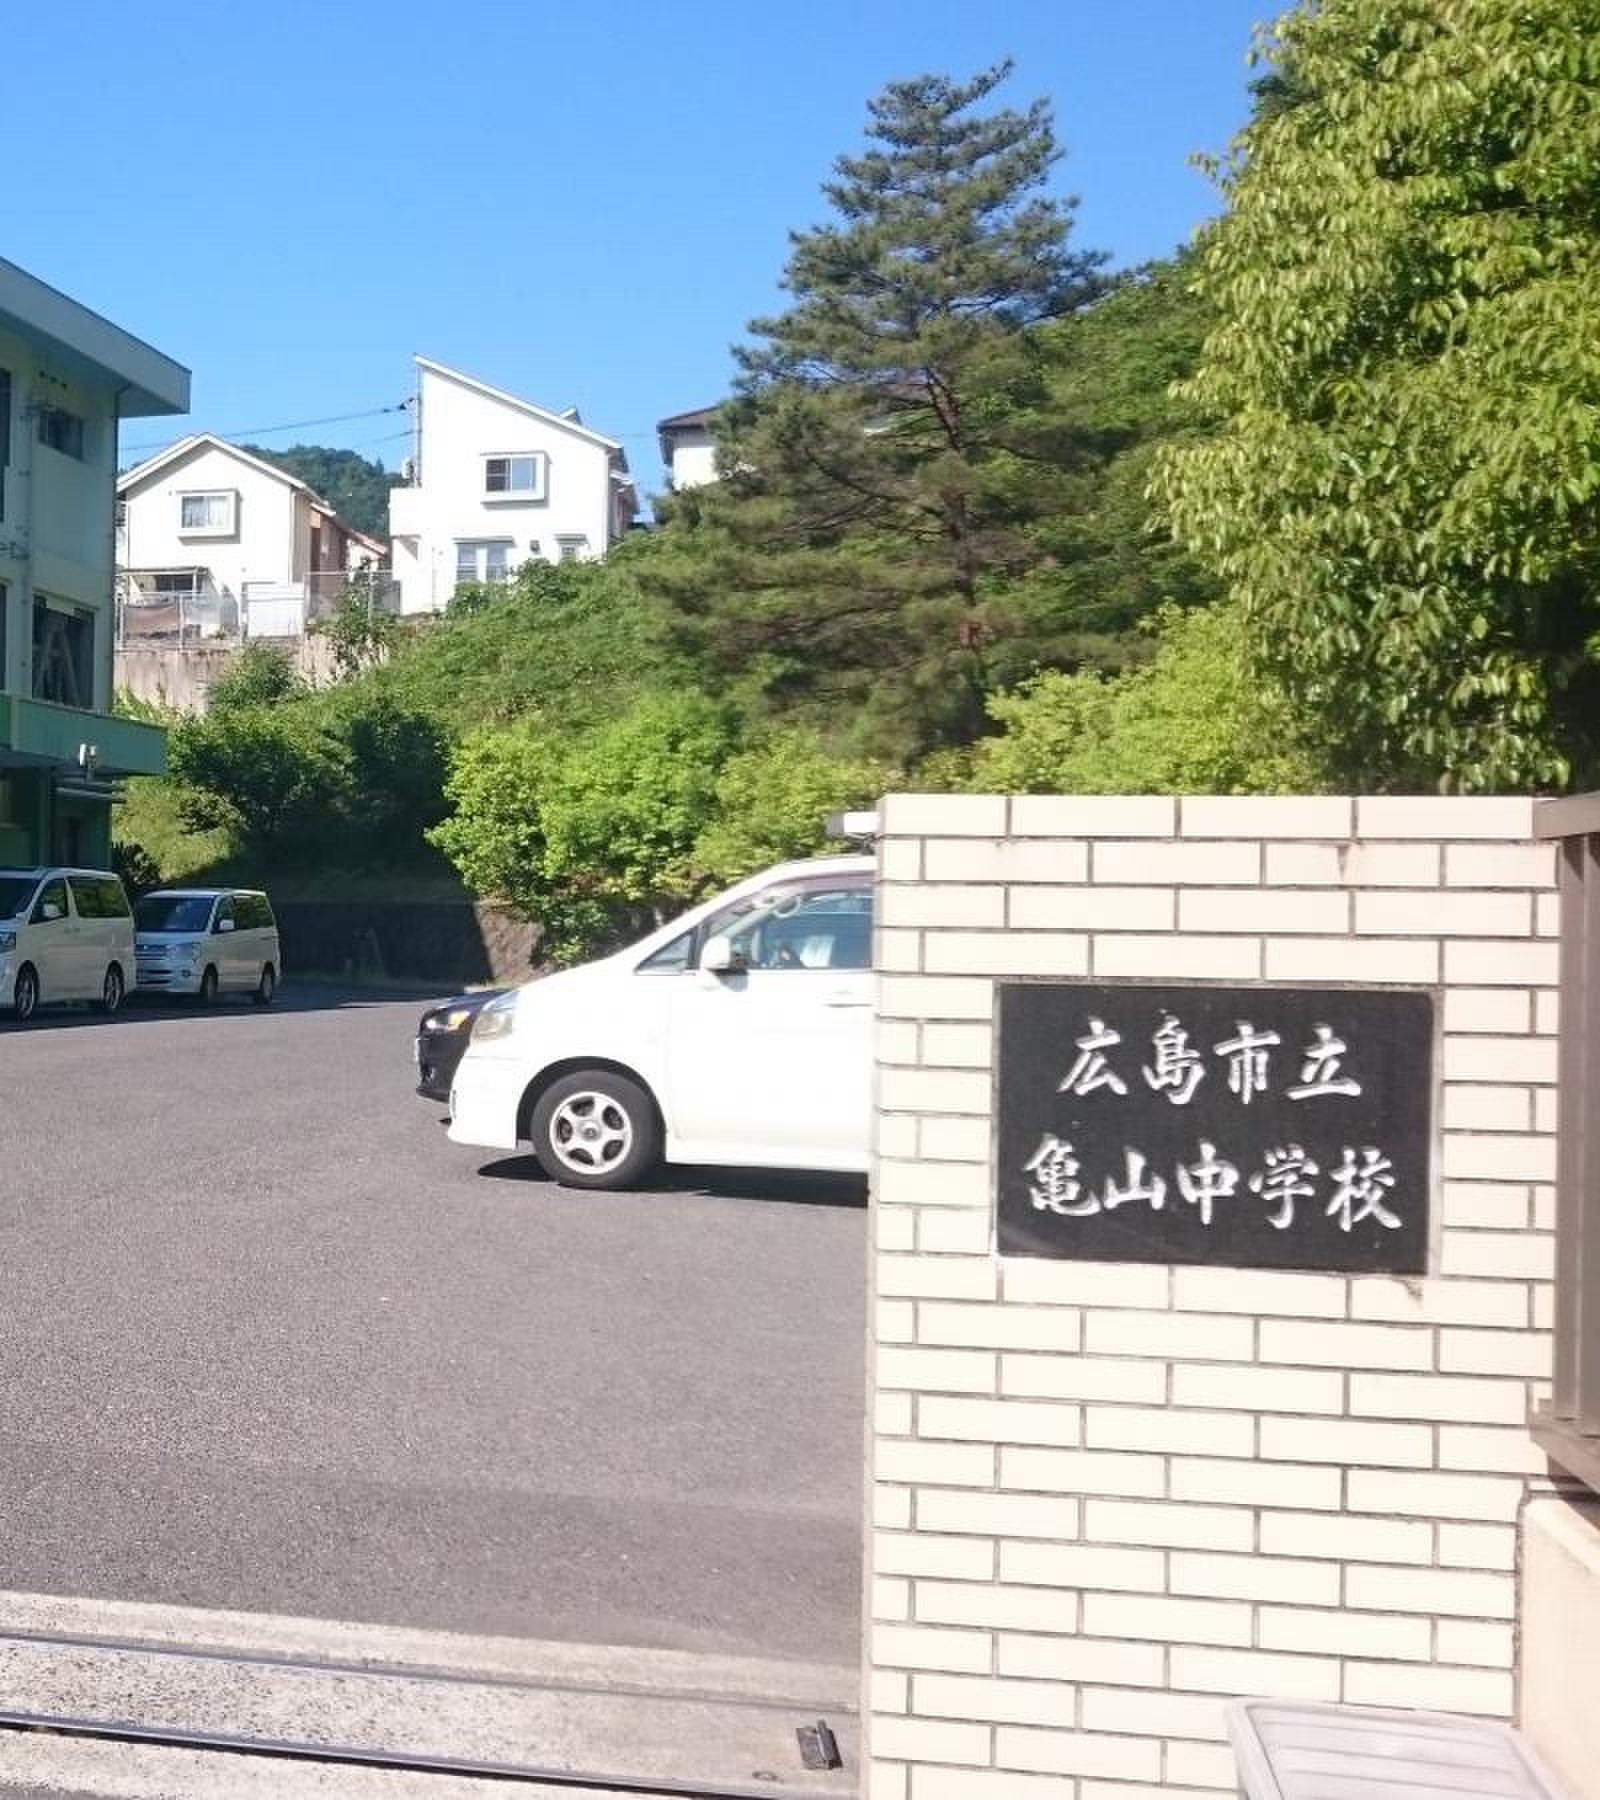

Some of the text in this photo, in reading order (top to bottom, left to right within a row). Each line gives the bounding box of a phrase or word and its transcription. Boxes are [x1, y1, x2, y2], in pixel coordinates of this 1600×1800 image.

[1056, 1015, 1363, 1105] 広島市立
[1022, 1133, 1403, 1232] 亀山中学校
